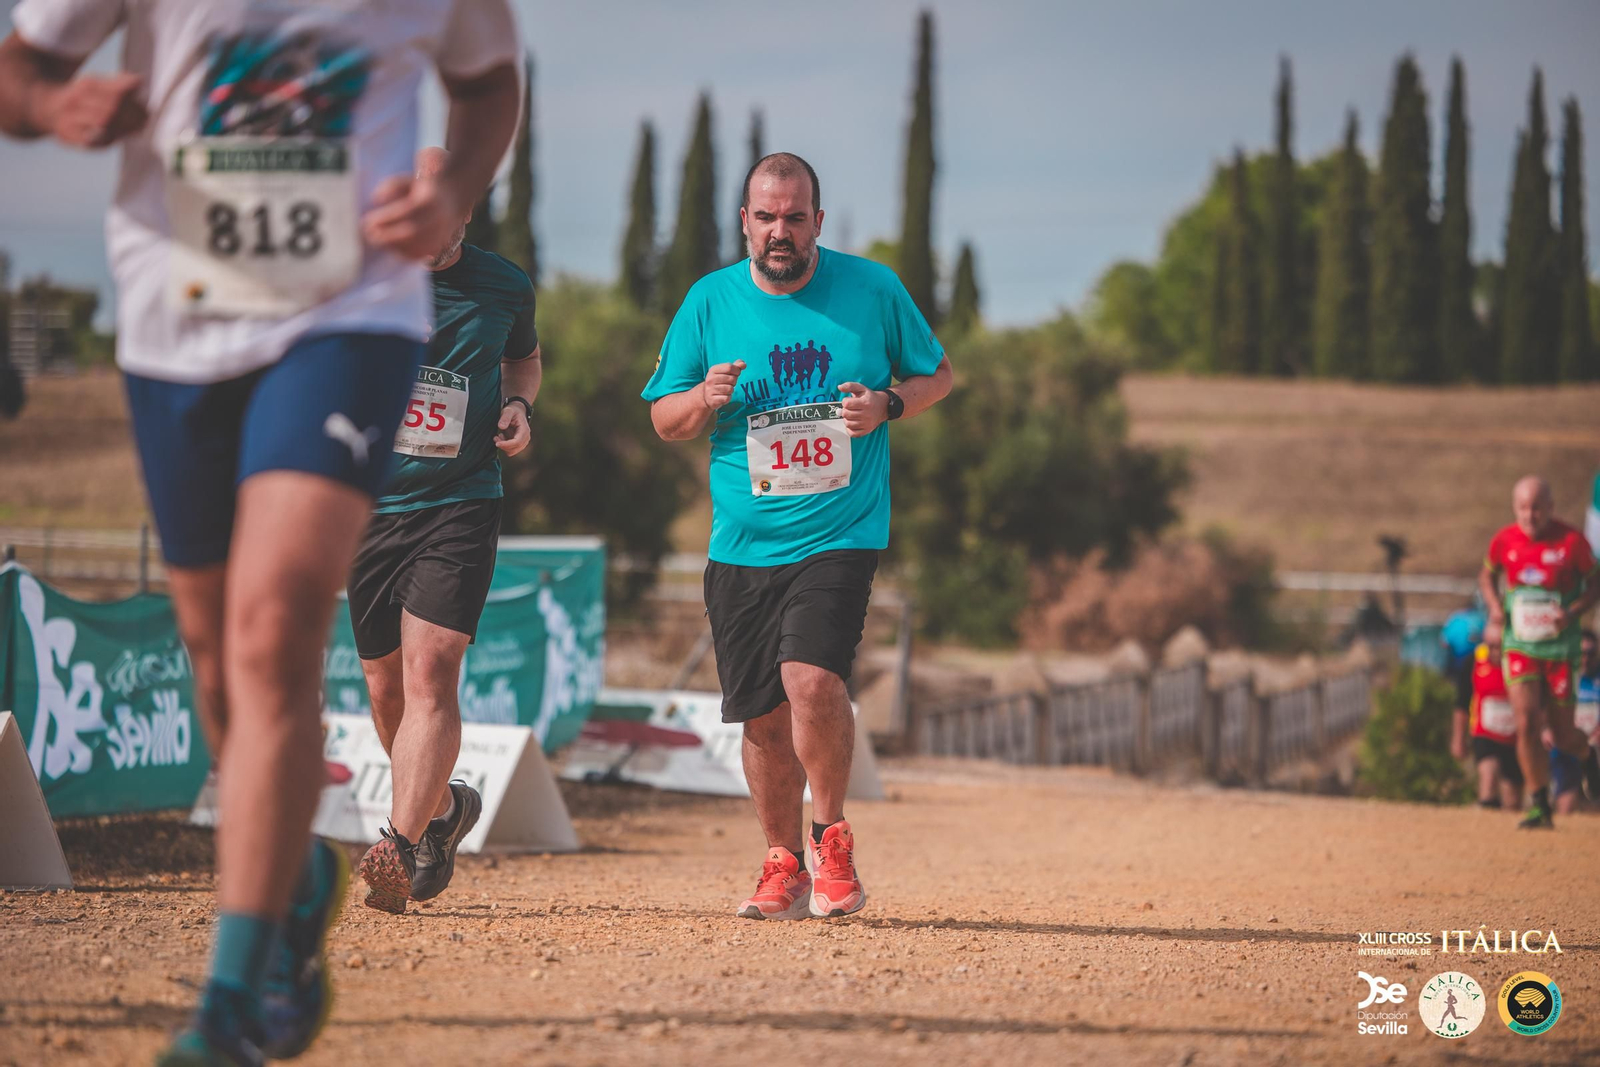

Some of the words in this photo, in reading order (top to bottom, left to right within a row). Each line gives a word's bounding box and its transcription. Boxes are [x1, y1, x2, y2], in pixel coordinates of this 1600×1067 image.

[206, 201, 322, 258] 818
[417, 370, 444, 384] LICA
[741, 378, 771, 404] XLII
[403, 398, 447, 432] 55
[776, 408, 822, 422] ITÁLICA
[770, 437, 834, 470] 148
